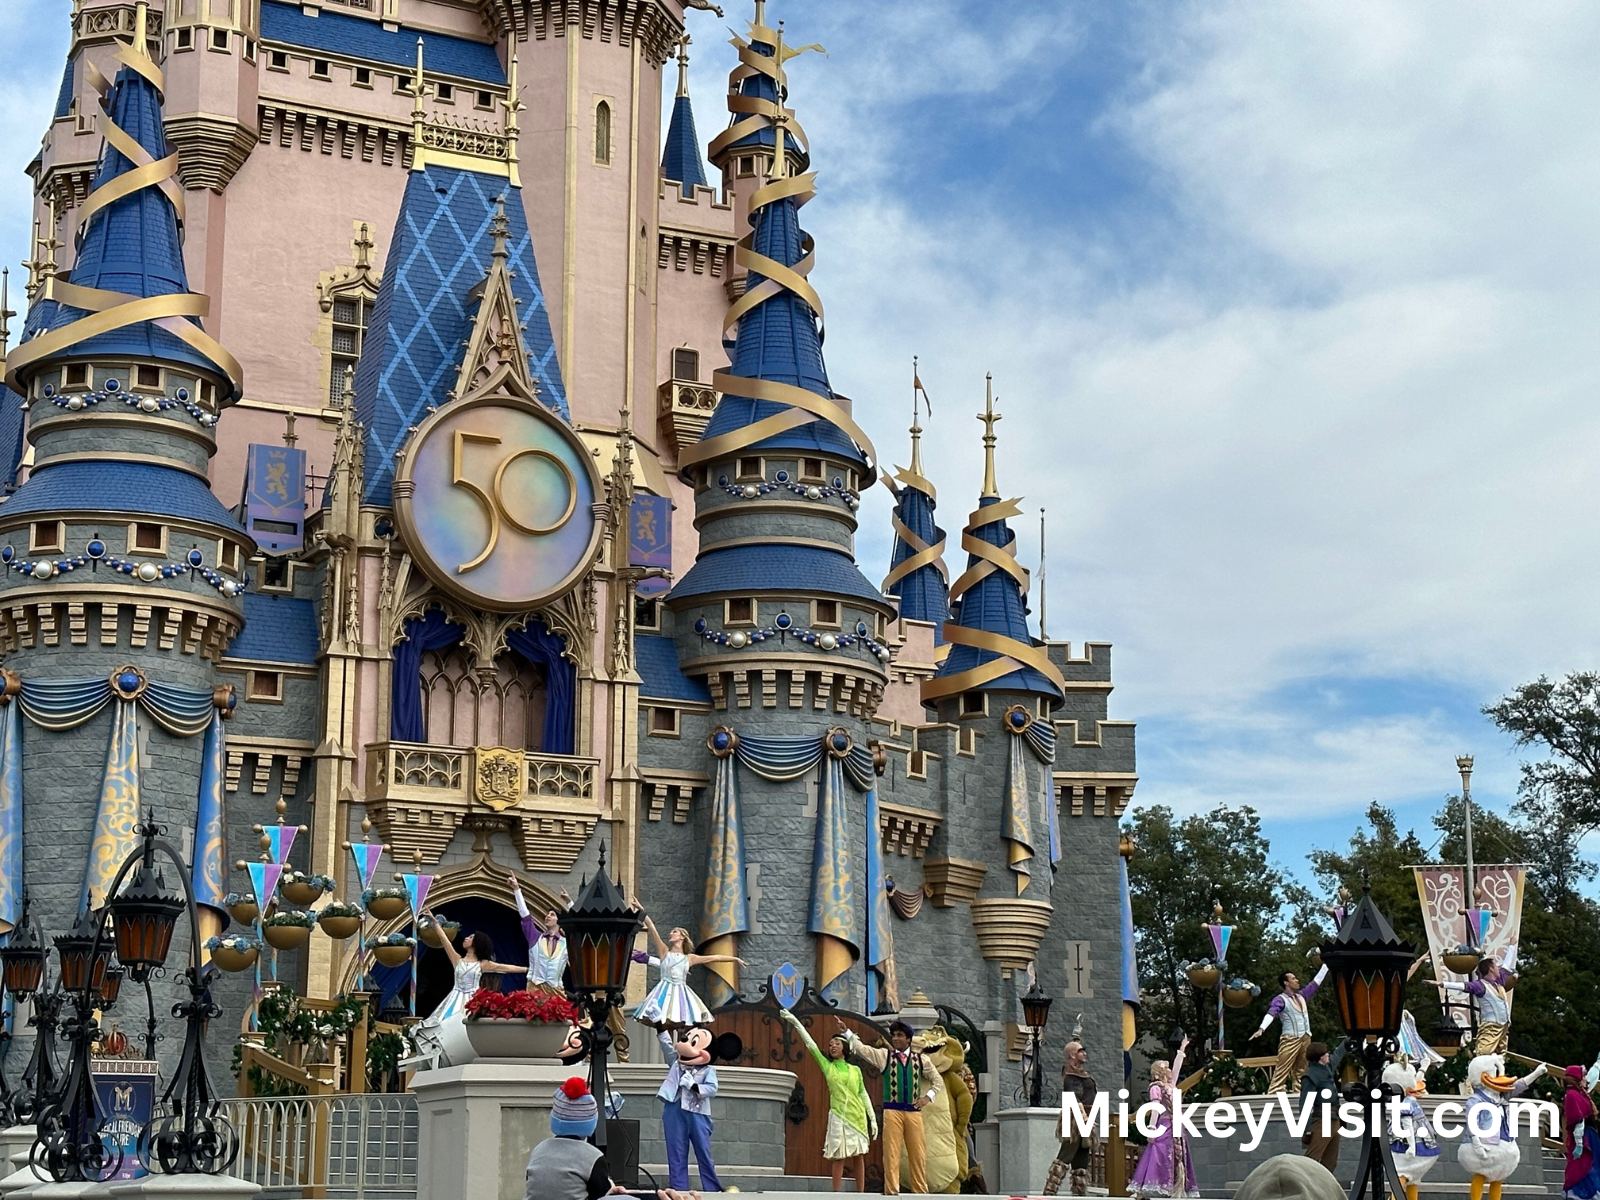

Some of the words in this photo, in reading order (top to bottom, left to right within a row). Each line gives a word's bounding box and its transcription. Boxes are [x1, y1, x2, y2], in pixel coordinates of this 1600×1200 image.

[453, 429, 578, 574] 50
[777, 973, 799, 999] M
[114, 1086, 133, 1112] M
